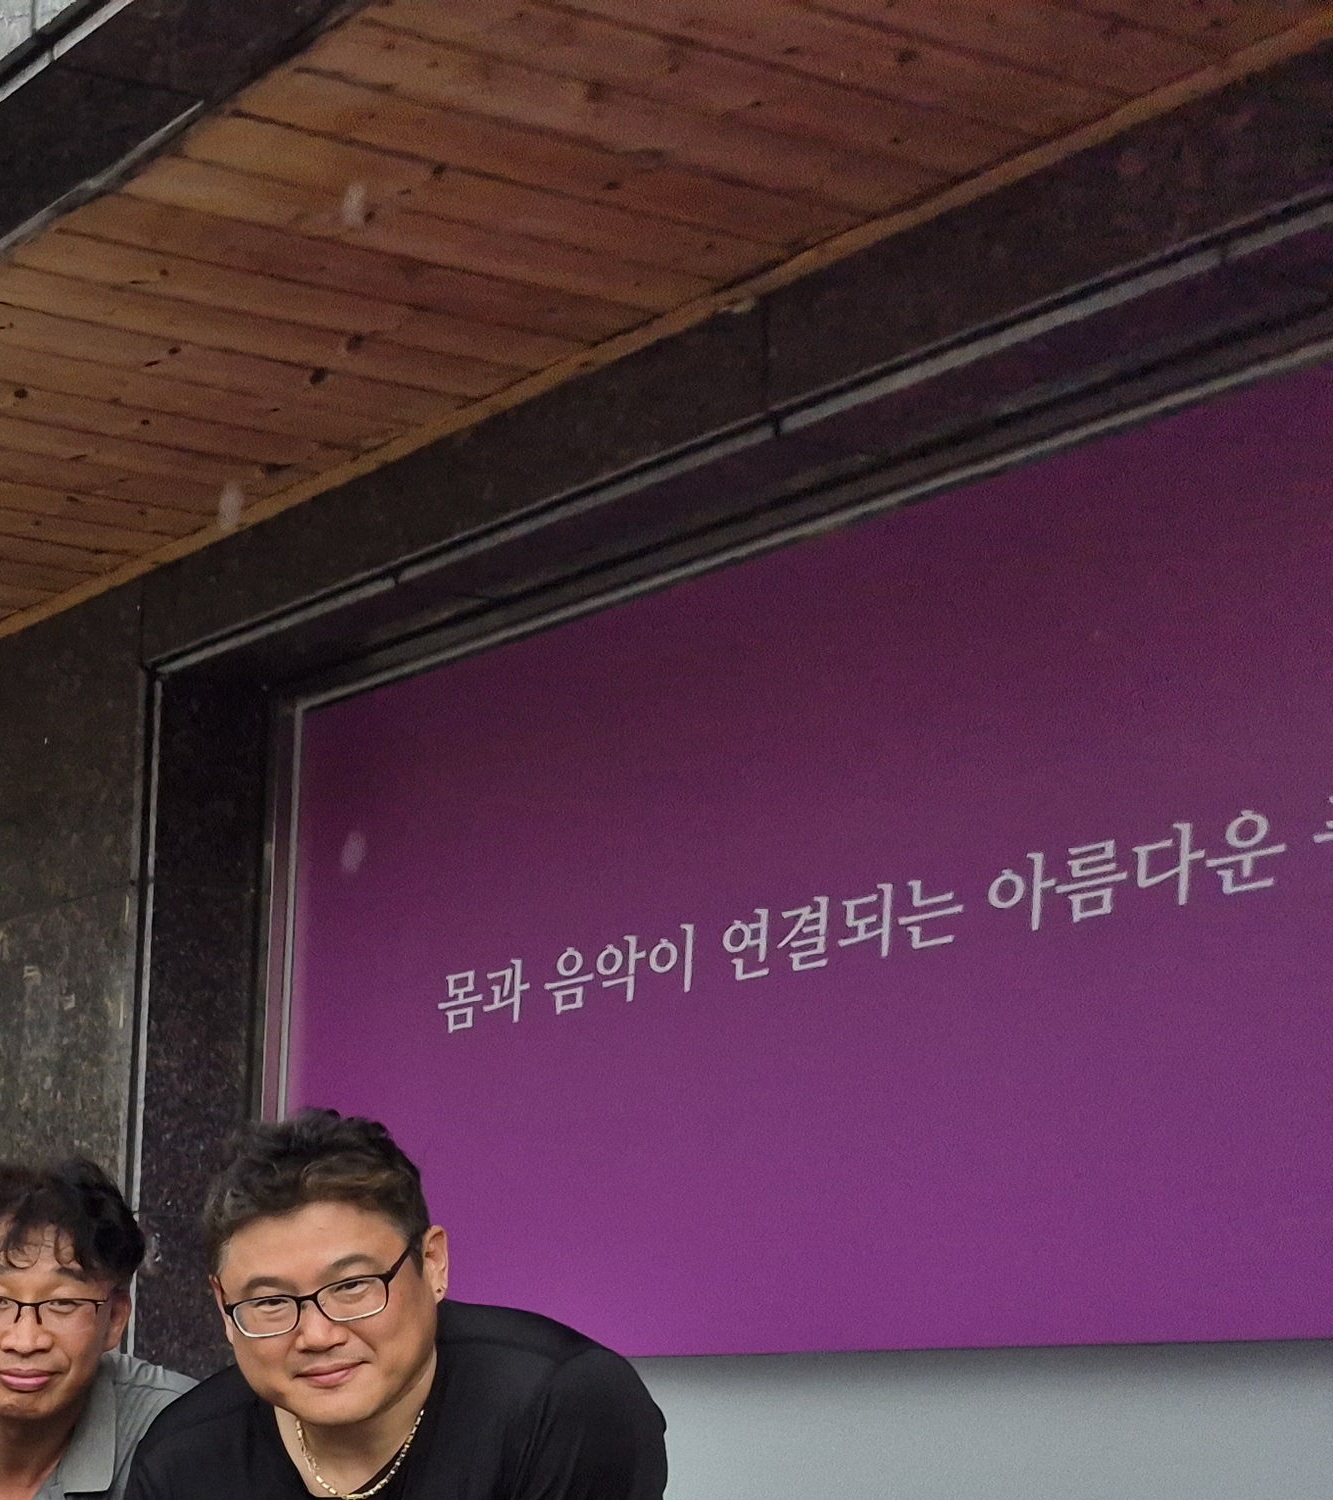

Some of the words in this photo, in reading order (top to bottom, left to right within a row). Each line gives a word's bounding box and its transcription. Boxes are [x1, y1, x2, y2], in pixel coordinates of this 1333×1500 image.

[437, 958, 531, 1034] 몸과
[542, 923, 696, 1016] 음악이
[721, 879, 965, 982] 연결되는
[987, 809, 1287, 932] 아름다운
